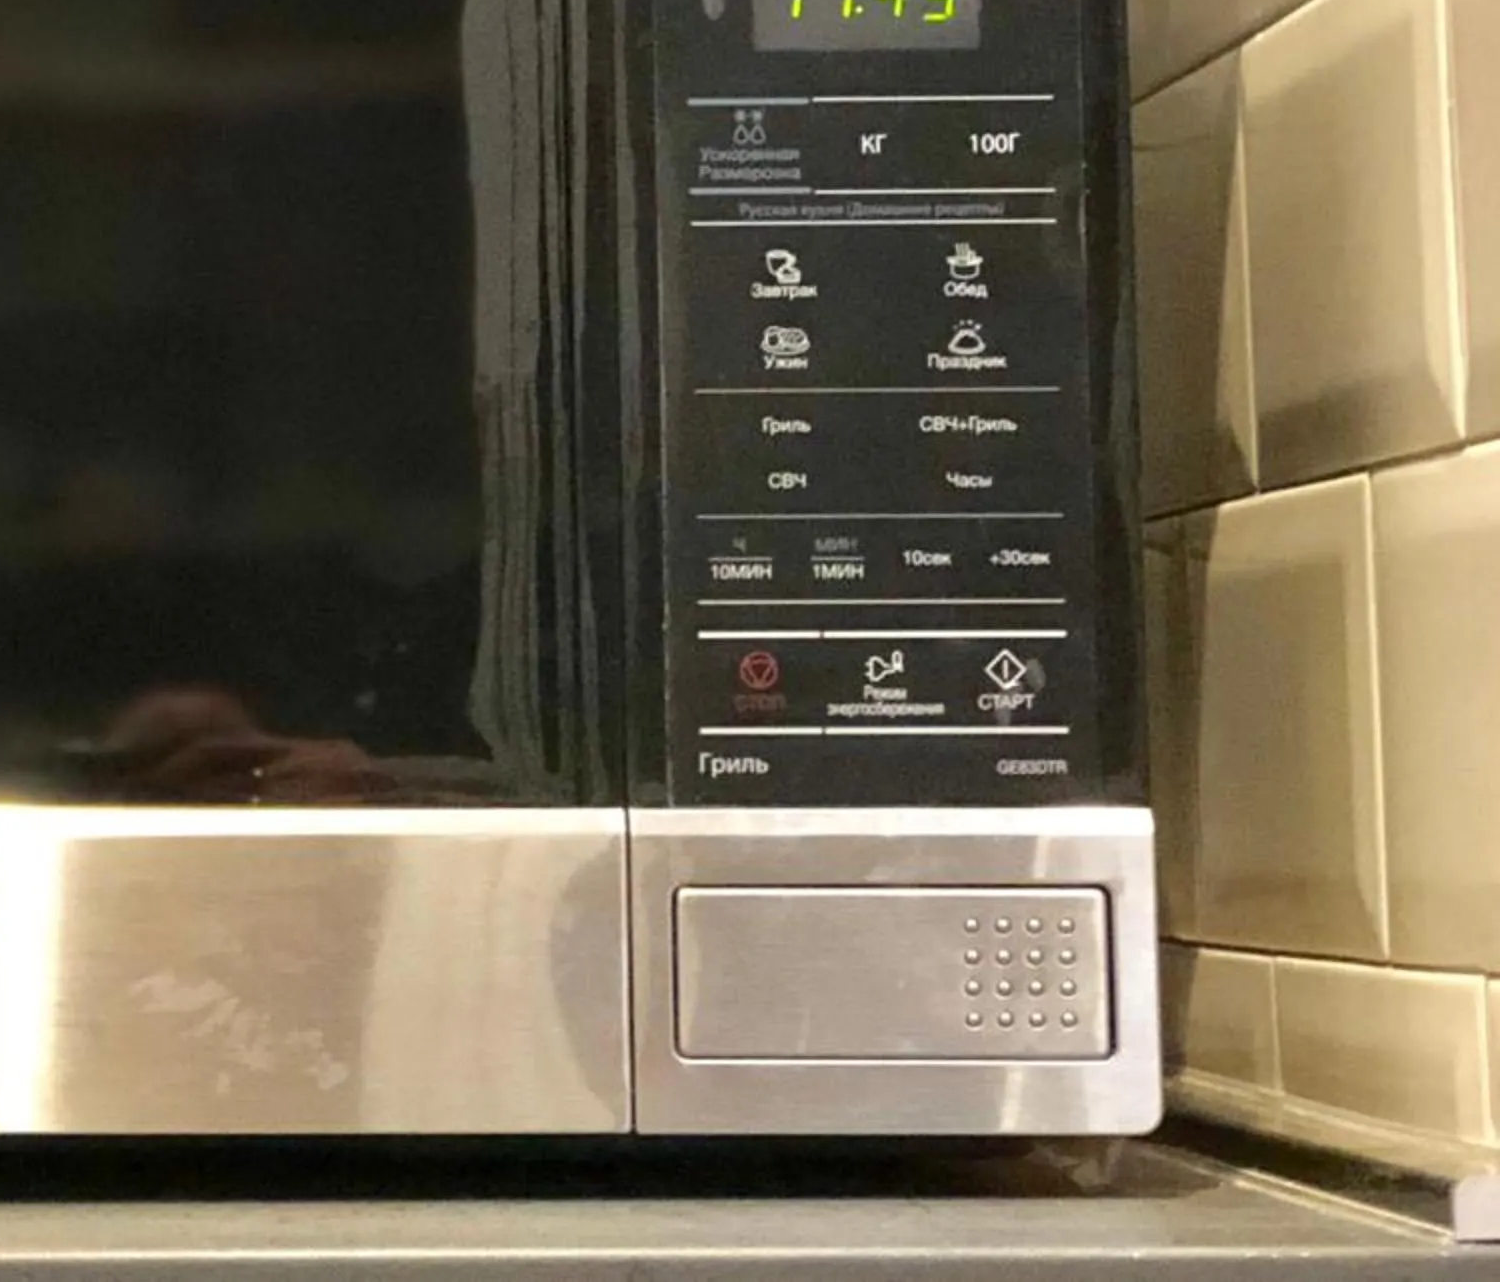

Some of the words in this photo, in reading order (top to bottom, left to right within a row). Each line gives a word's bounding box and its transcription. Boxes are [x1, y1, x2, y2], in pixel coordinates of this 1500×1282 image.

[751, 283, 817, 300] Завтрак
[943, 282, 988, 300] Обед
[764, 355, 808, 371] Ужин
[927, 353, 1007, 371] Праздник
[762, 418, 811, 435] Гриль
[767, 473, 807, 490] СВЧ
[946, 472, 993, 489] Часы
[711, 563, 773, 581] 10МИН
[976, 693, 1035, 711] СТАРТ
[699, 753, 770, 776] Гриль
